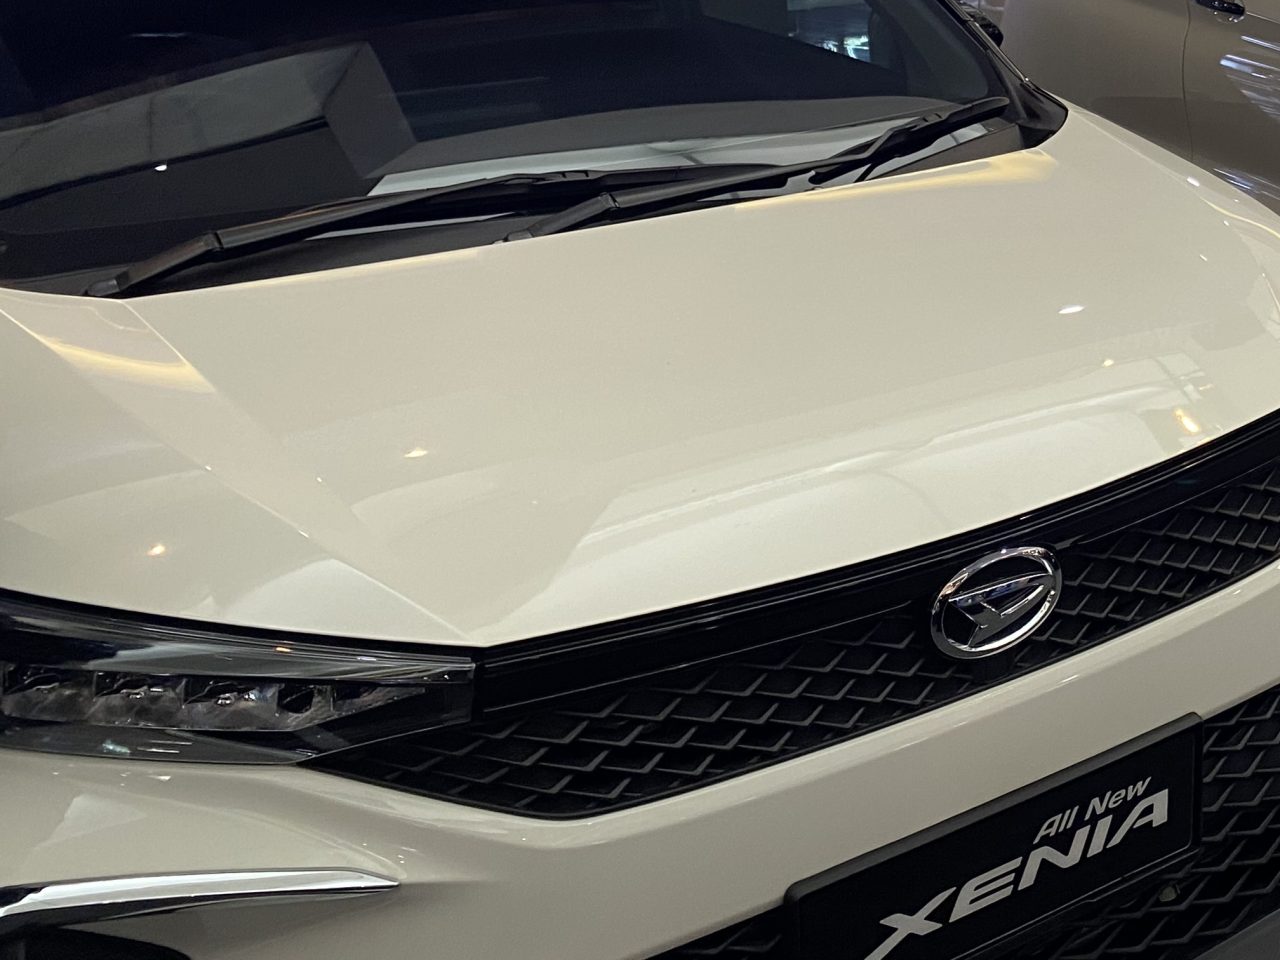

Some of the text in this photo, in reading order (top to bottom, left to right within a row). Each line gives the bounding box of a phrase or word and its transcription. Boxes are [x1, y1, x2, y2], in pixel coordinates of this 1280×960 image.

[1033, 776, 1152, 844] All New
[863, 788, 1170, 960] XENIA
